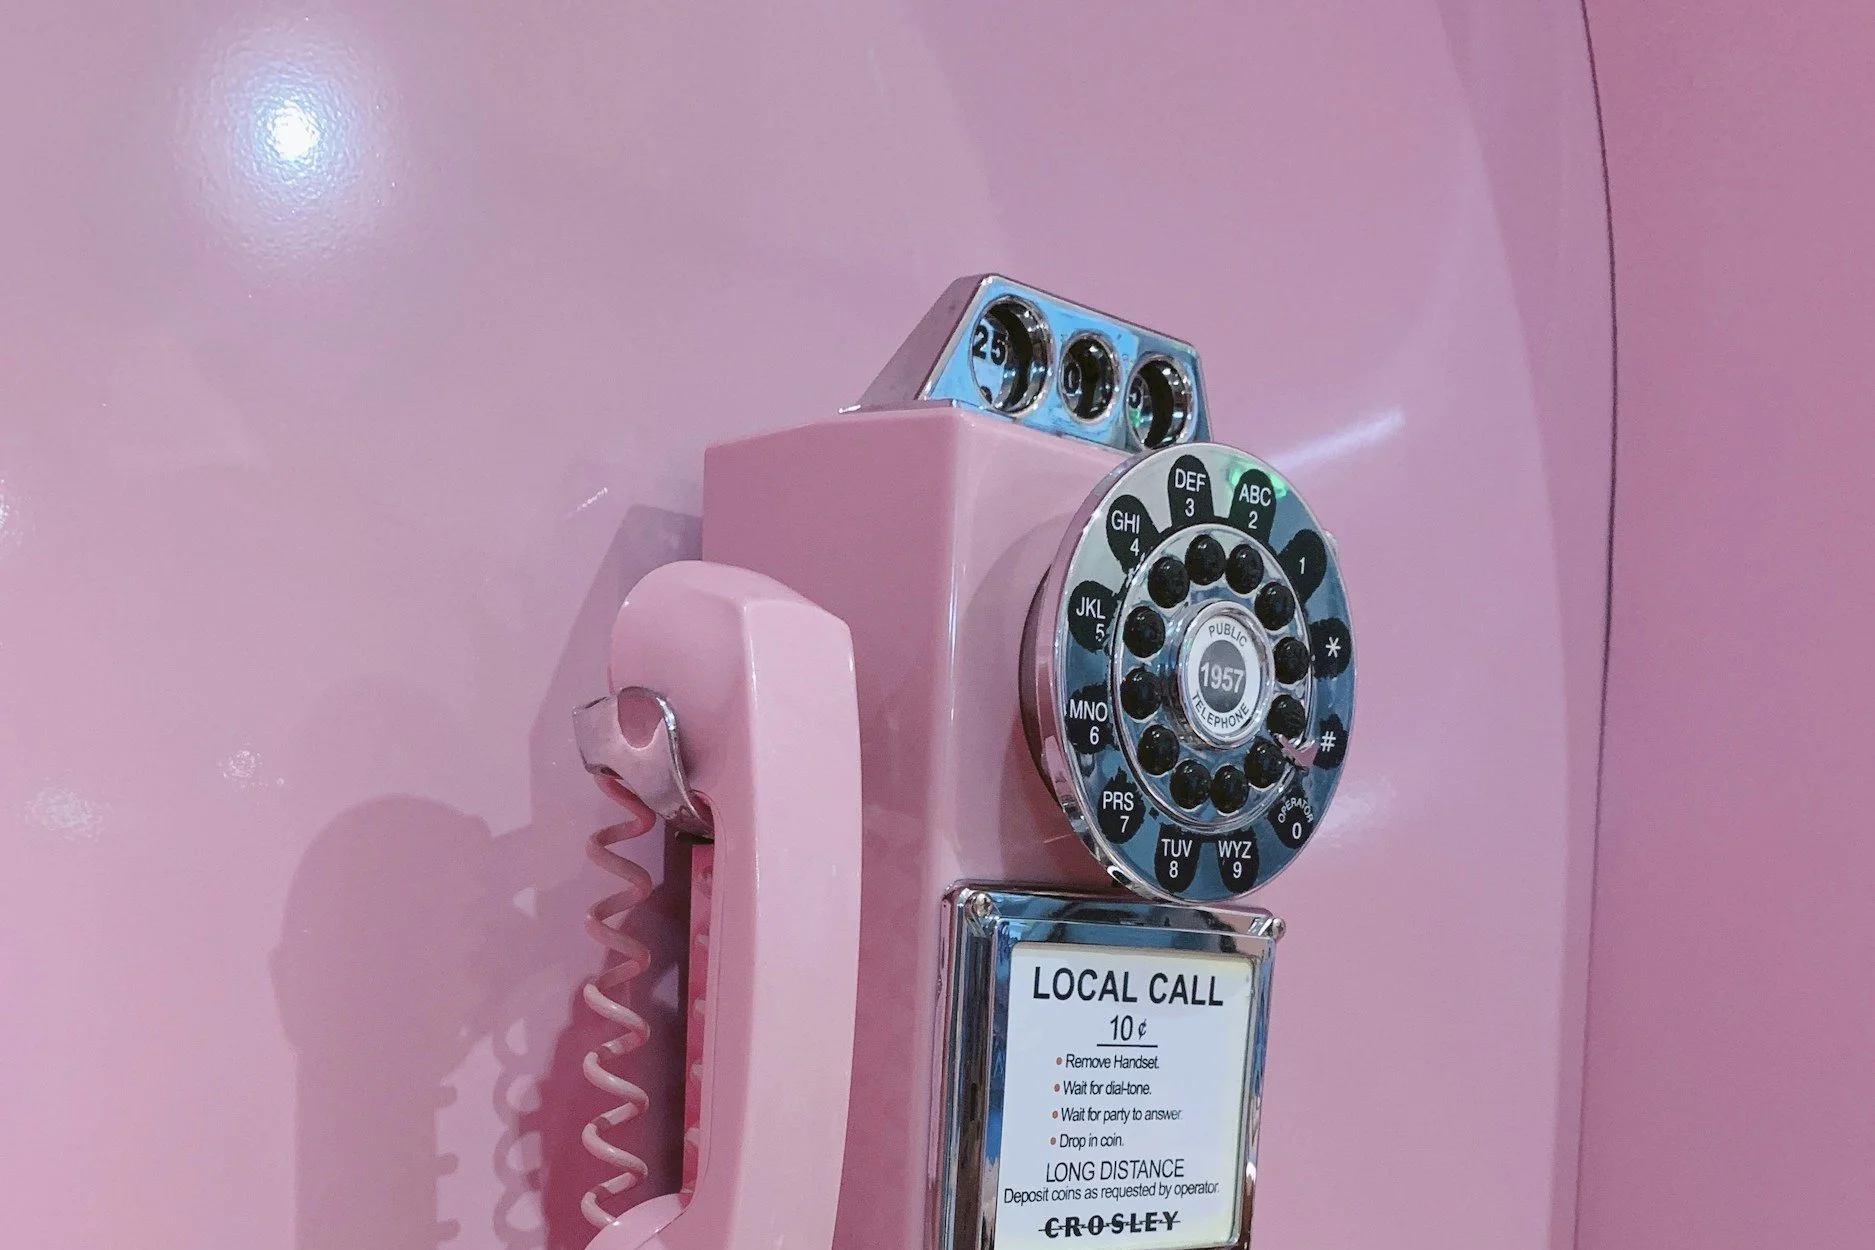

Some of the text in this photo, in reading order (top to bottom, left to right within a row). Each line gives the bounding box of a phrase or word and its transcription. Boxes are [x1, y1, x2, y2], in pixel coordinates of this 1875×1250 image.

[1174, 468, 1206, 493] DEF
[1238, 483, 1272, 507] ABC
[1184, 498, 1195, 517] 3
[1111, 509, 1140, 534] GHI
[1248, 511, 1258, 530] 2
[1129, 537, 1140, 557] 4
[1298, 557, 1306, 574] 1
[1075, 595, 1106, 620] JKL
[1095, 623, 1105, 642] 5
[1208, 622, 1248, 648] PUBLIC
[1200, 661, 1244, 694] 1957
[1069, 699, 1107, 723] MNO
[1192, 691, 1250, 729] TELEPHONE
[1089, 726, 1099, 745] 6
[1321, 730, 1336, 753] #
[1103, 790, 1134, 812] PRS
[1277, 797, 1314, 823] OPERATOR
[1120, 815, 1130, 833] 7
[1292, 822, 1302, 840] 0
[1160, 838, 1193, 858] TUV
[1218, 840, 1251, 860] WYZ
[1169, 860, 1179, 879] 8
[1232, 860, 1243, 879] 9
[1033, 966, 1224, 1006] LOCAL CALL
[1065, 1053, 1160, 1069] Remove Handset.
[1062, 1080, 1152, 1095] Wait for dial-tone.
[1061, 1107, 1086, 1122] Wait
[1087, 1107, 1102, 1121] for
[1103, 1107, 1131, 1124] party
[1132, 1107, 1143, 1121] to
[1060, 1132, 1125, 1151] Drop in coin.
[1046, 1158, 1185, 1182] LONG DISTANCE
[1003, 1180, 1220, 1207] Deposit coins as requested by operator.
[1043, 1210, 1180, 1239] CROSLEY
